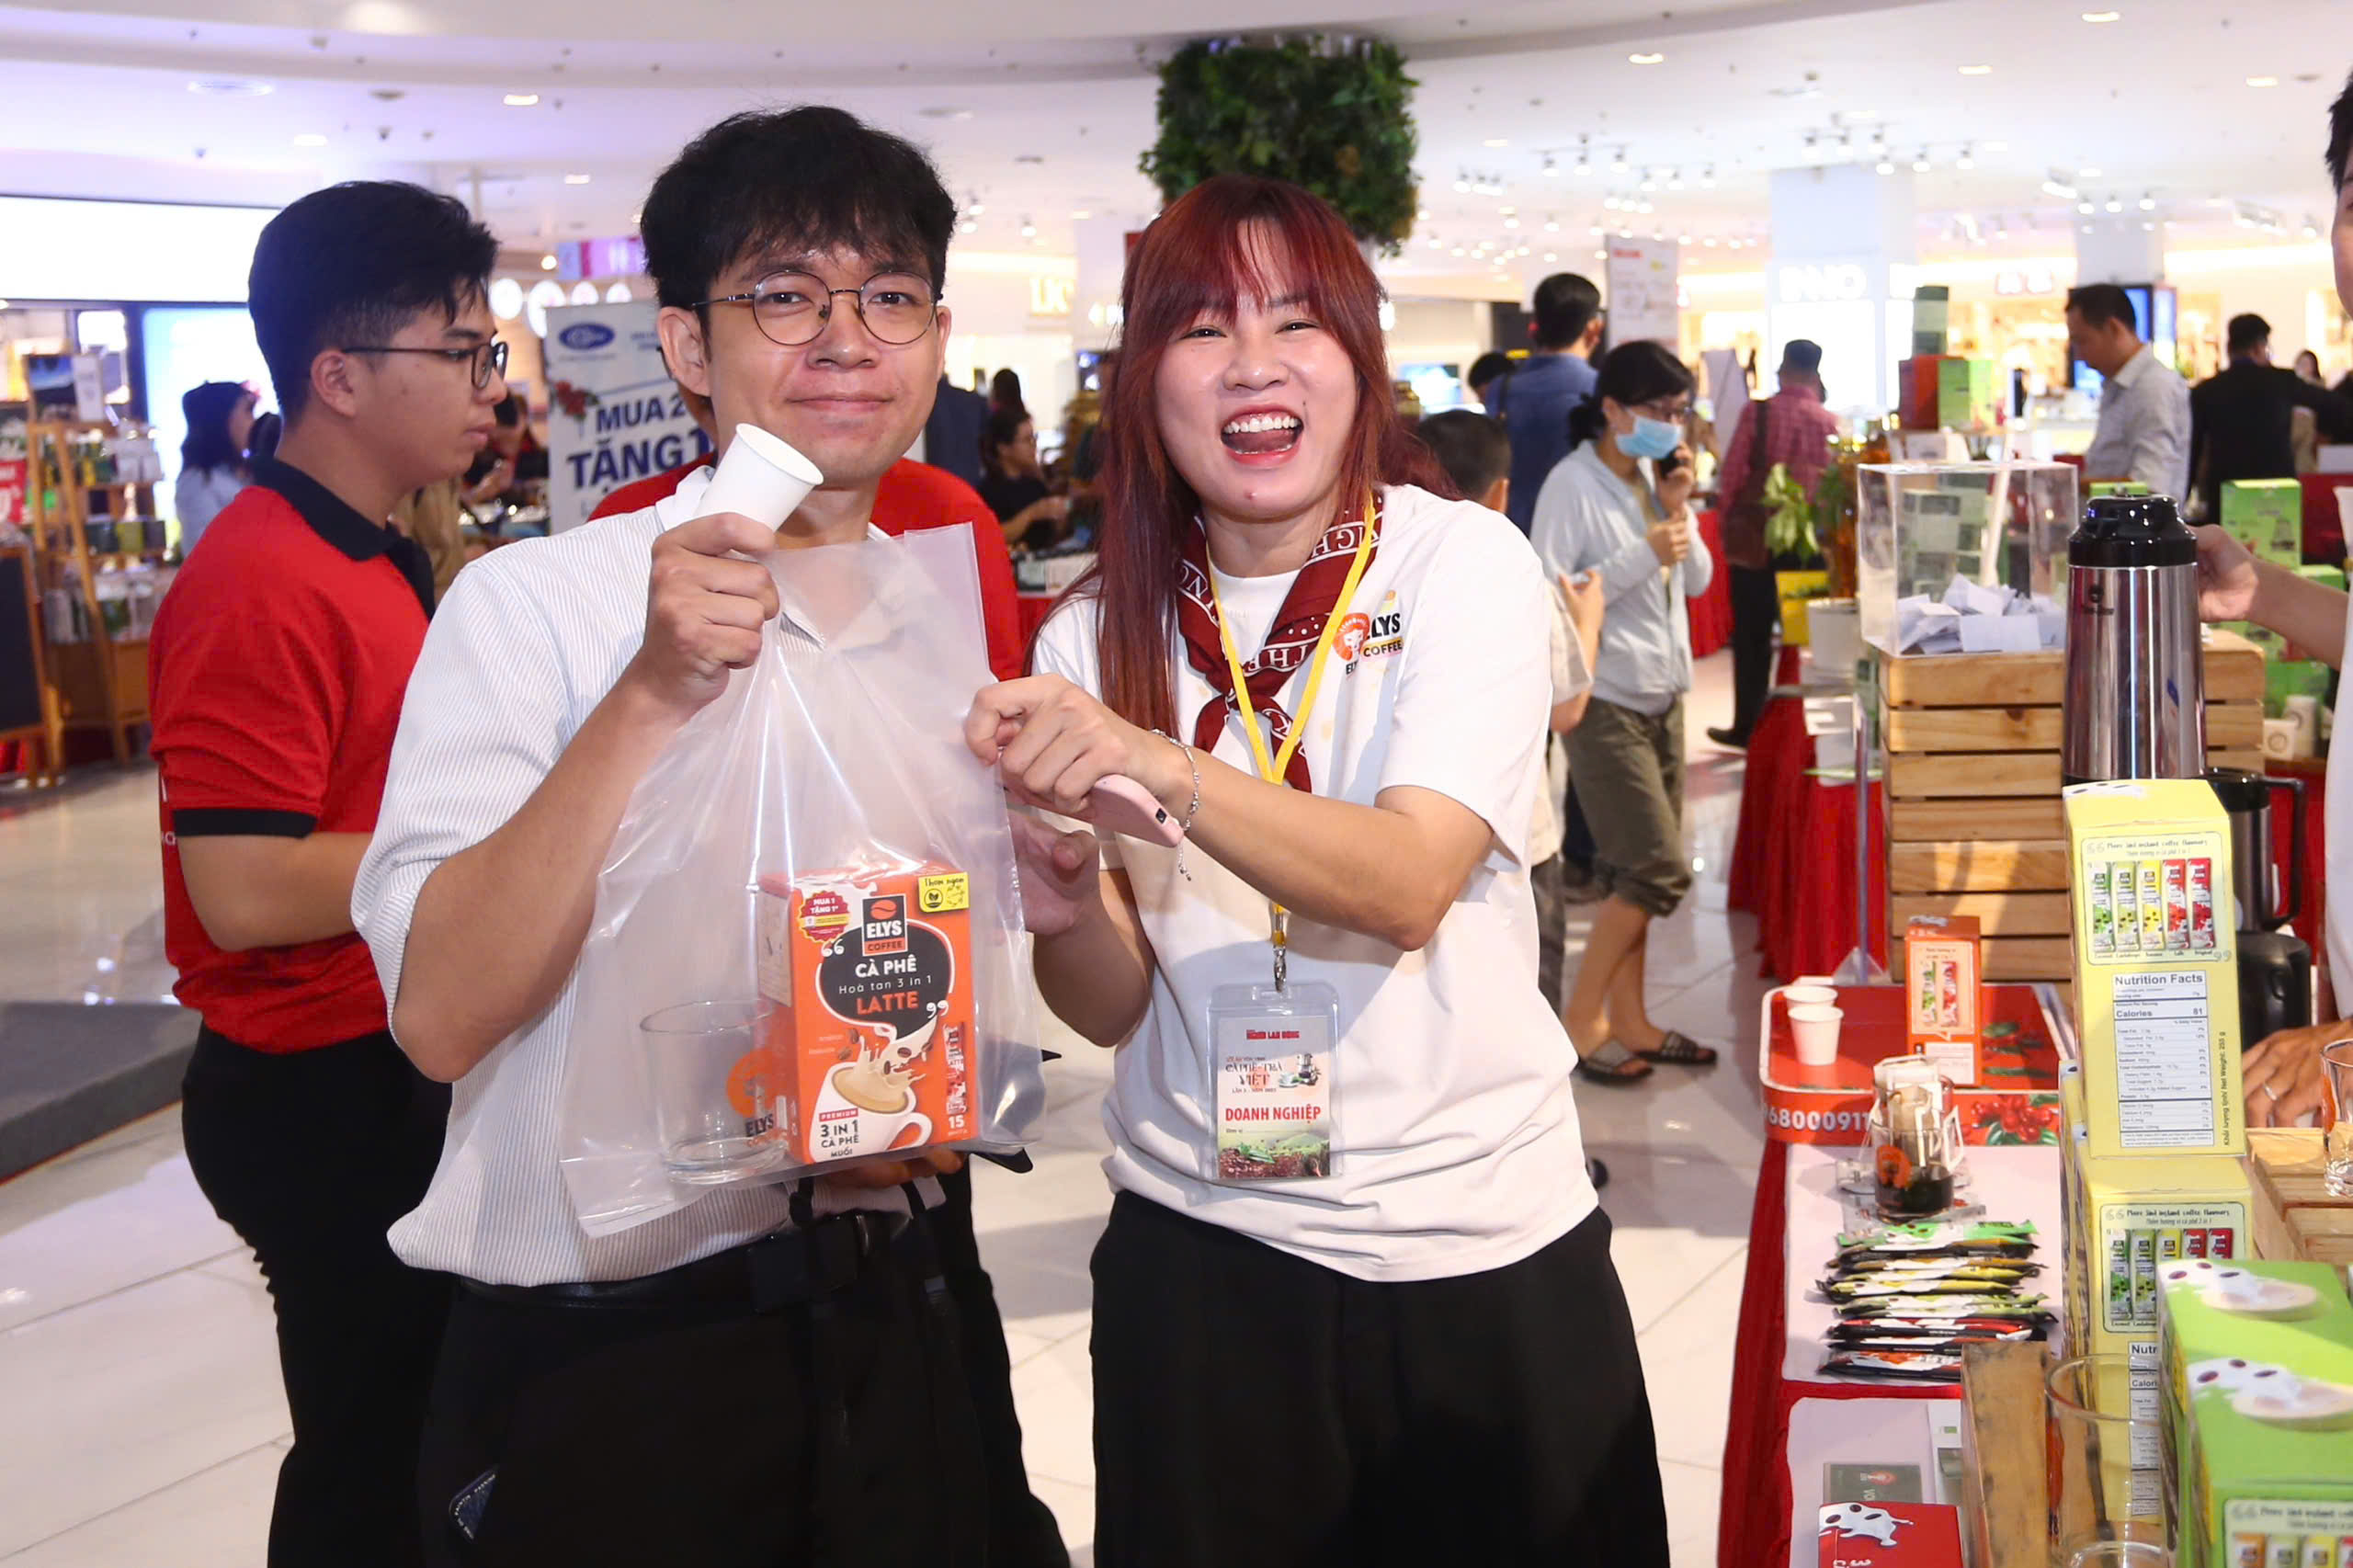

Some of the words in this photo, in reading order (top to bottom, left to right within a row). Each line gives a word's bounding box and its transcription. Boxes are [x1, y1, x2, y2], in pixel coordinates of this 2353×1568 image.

[596, 397, 665, 434] MUA
[669, 393, 688, 418] 2
[566, 435, 685, 494] TẶNG
[1366, 612, 1401, 641] LYS
[1363, 640, 1403, 658] COFFEE
[866, 920, 903, 938] ELYS
[867, 940, 903, 952] COFFEE
[855, 958, 880, 979] CÀ
[883, 954, 917, 975] PHÊ
[838, 983, 865, 994] Hoà
[870, 981, 892, 991] tan
[897, 978, 904, 988] 3
[910, 976, 921, 986] in
[926, 974, 932, 983] 1
[2115, 974, 2166, 986] Nutrition
[2170, 972, 2203, 983] Facts
[857, 991, 919, 1016] LATTE
[2116, 1009, 2153, 1017] Calories
[2193, 1007, 2203, 1016] 81
[821, 1109, 858, 1119] PREMIUM
[948, 1113, 964, 1130] 15
[1225, 1107, 1269, 1121] DOANH
[1273, 1103, 1322, 1124] NGHIỆP
[745, 1113, 774, 1138] ELYS
[820, 1124, 829, 1138] 3
[833, 1122, 848, 1136] IN
[852, 1119, 858, 1133] 1
[821, 1135, 835, 1149] CÀ
[838, 1132, 859, 1145] PHÊ
